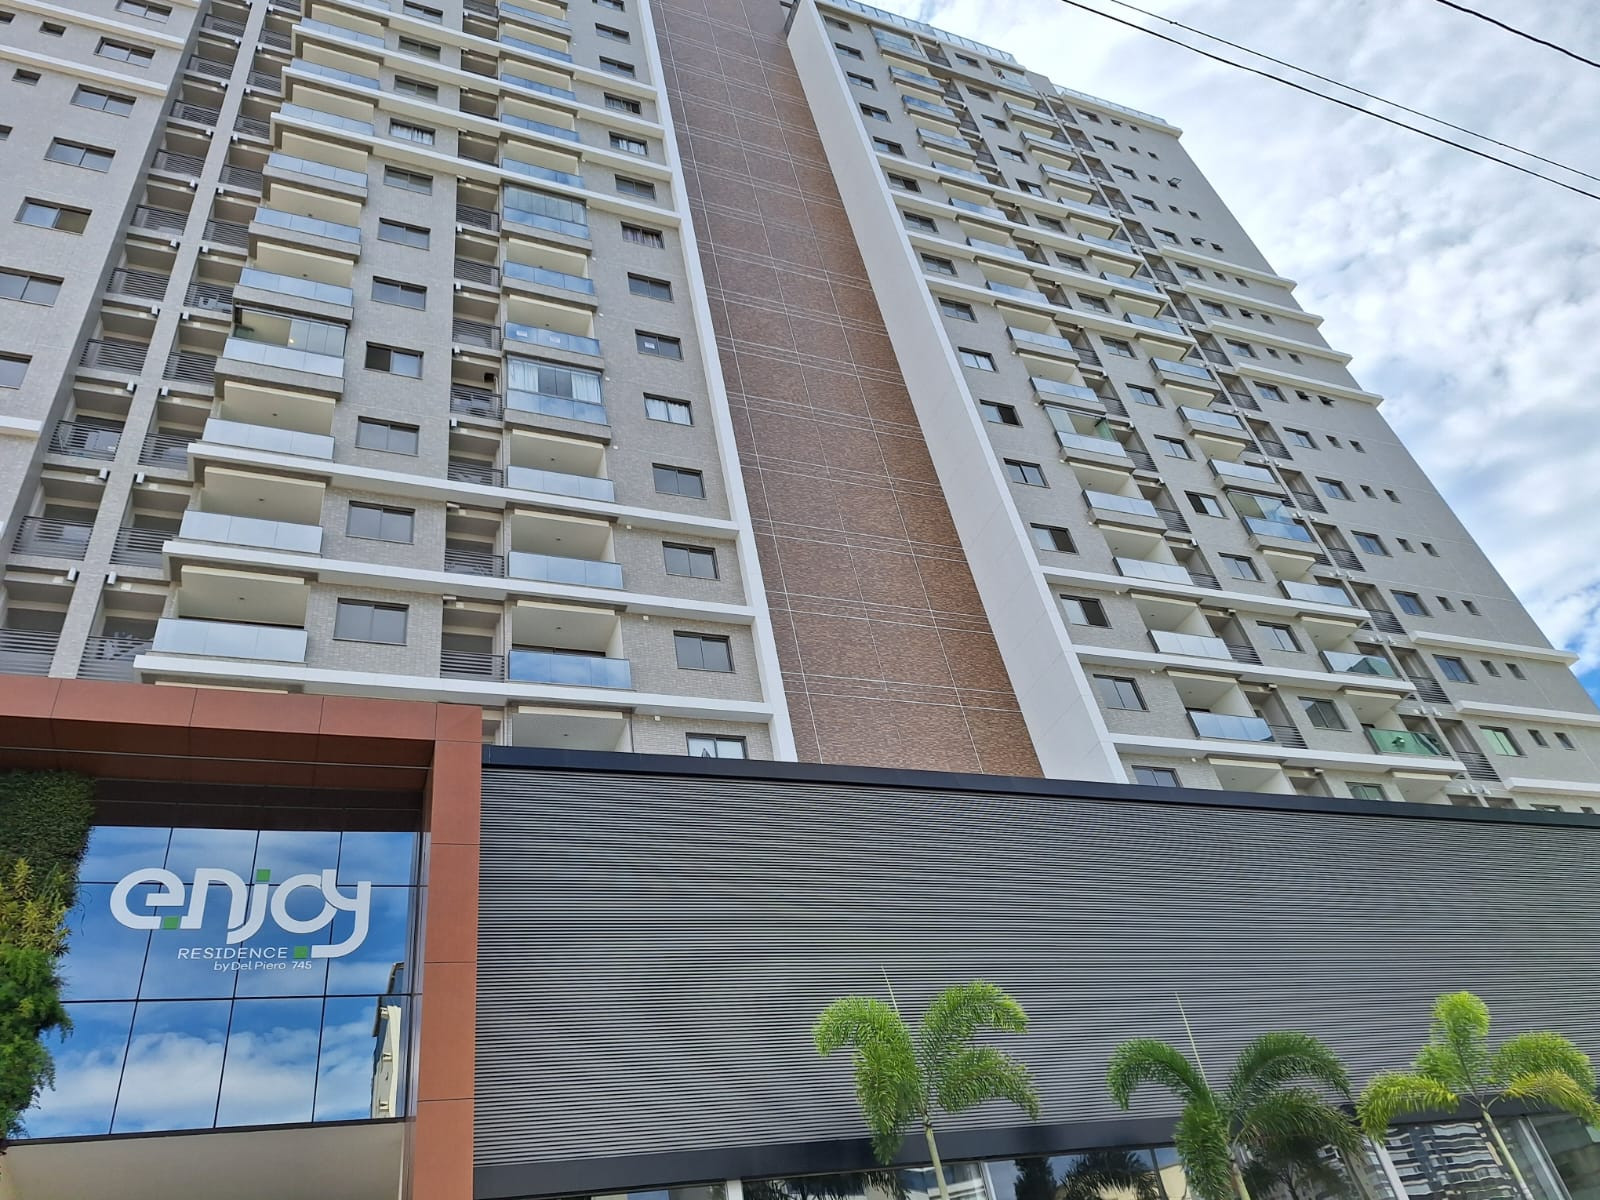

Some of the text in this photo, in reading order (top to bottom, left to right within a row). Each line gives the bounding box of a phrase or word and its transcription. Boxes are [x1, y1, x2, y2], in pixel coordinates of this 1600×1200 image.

[177, 946, 288, 960] RESIDENCE
[213, 960, 312, 972] by Del Piero 745
